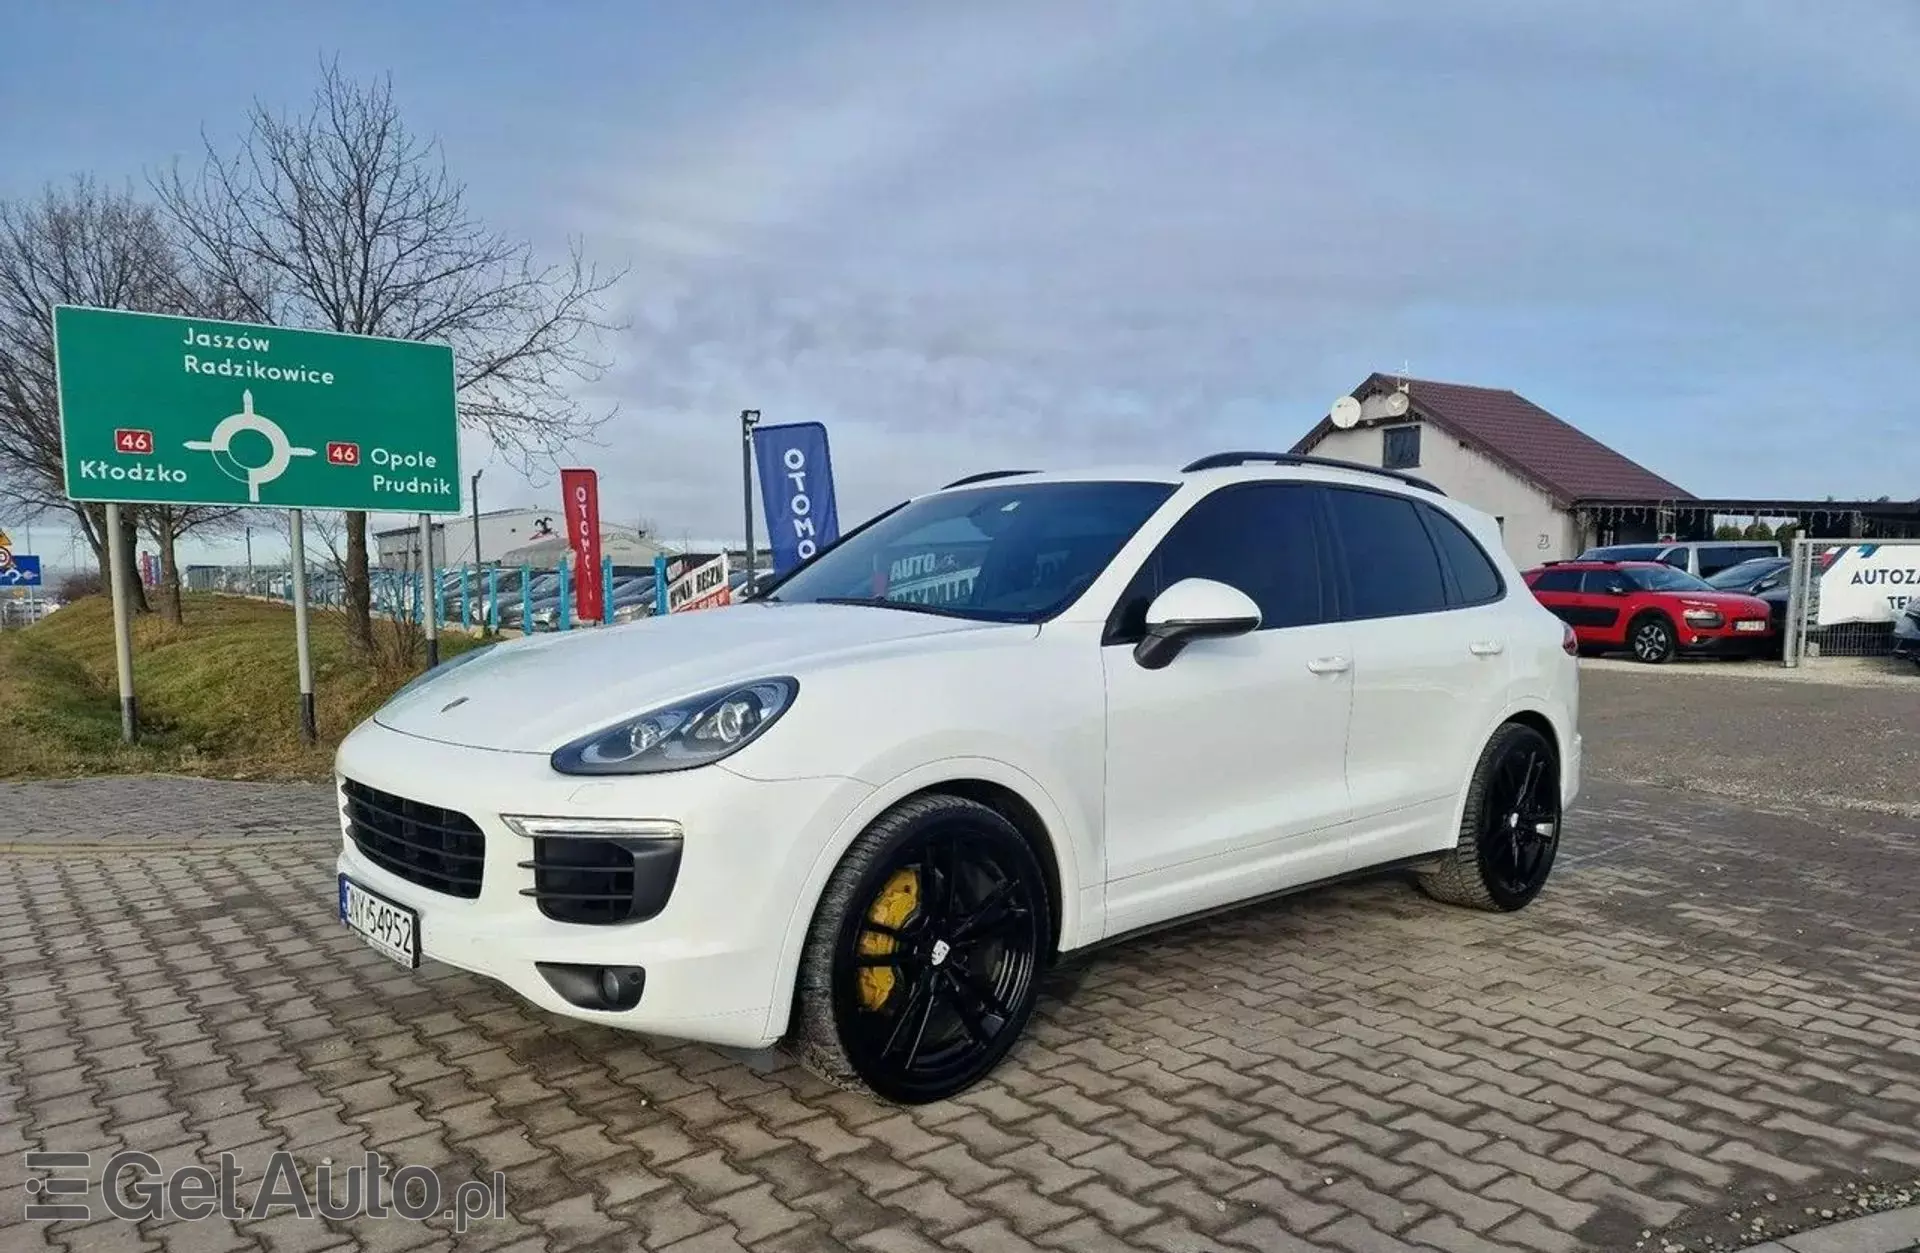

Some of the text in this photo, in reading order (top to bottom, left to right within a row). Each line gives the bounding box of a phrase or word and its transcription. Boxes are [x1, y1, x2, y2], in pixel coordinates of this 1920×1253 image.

[183, 327, 270, 352] Jaszów
[184, 355, 335, 384] Radzikowice
[121, 433, 148, 450] 46
[332, 446, 356, 462] 46
[370, 448, 437, 471] Opole
[80, 460, 187, 482] Kłodzko
[373, 474, 451, 495] Prudnik
[368, 898, 412, 955] 54952
